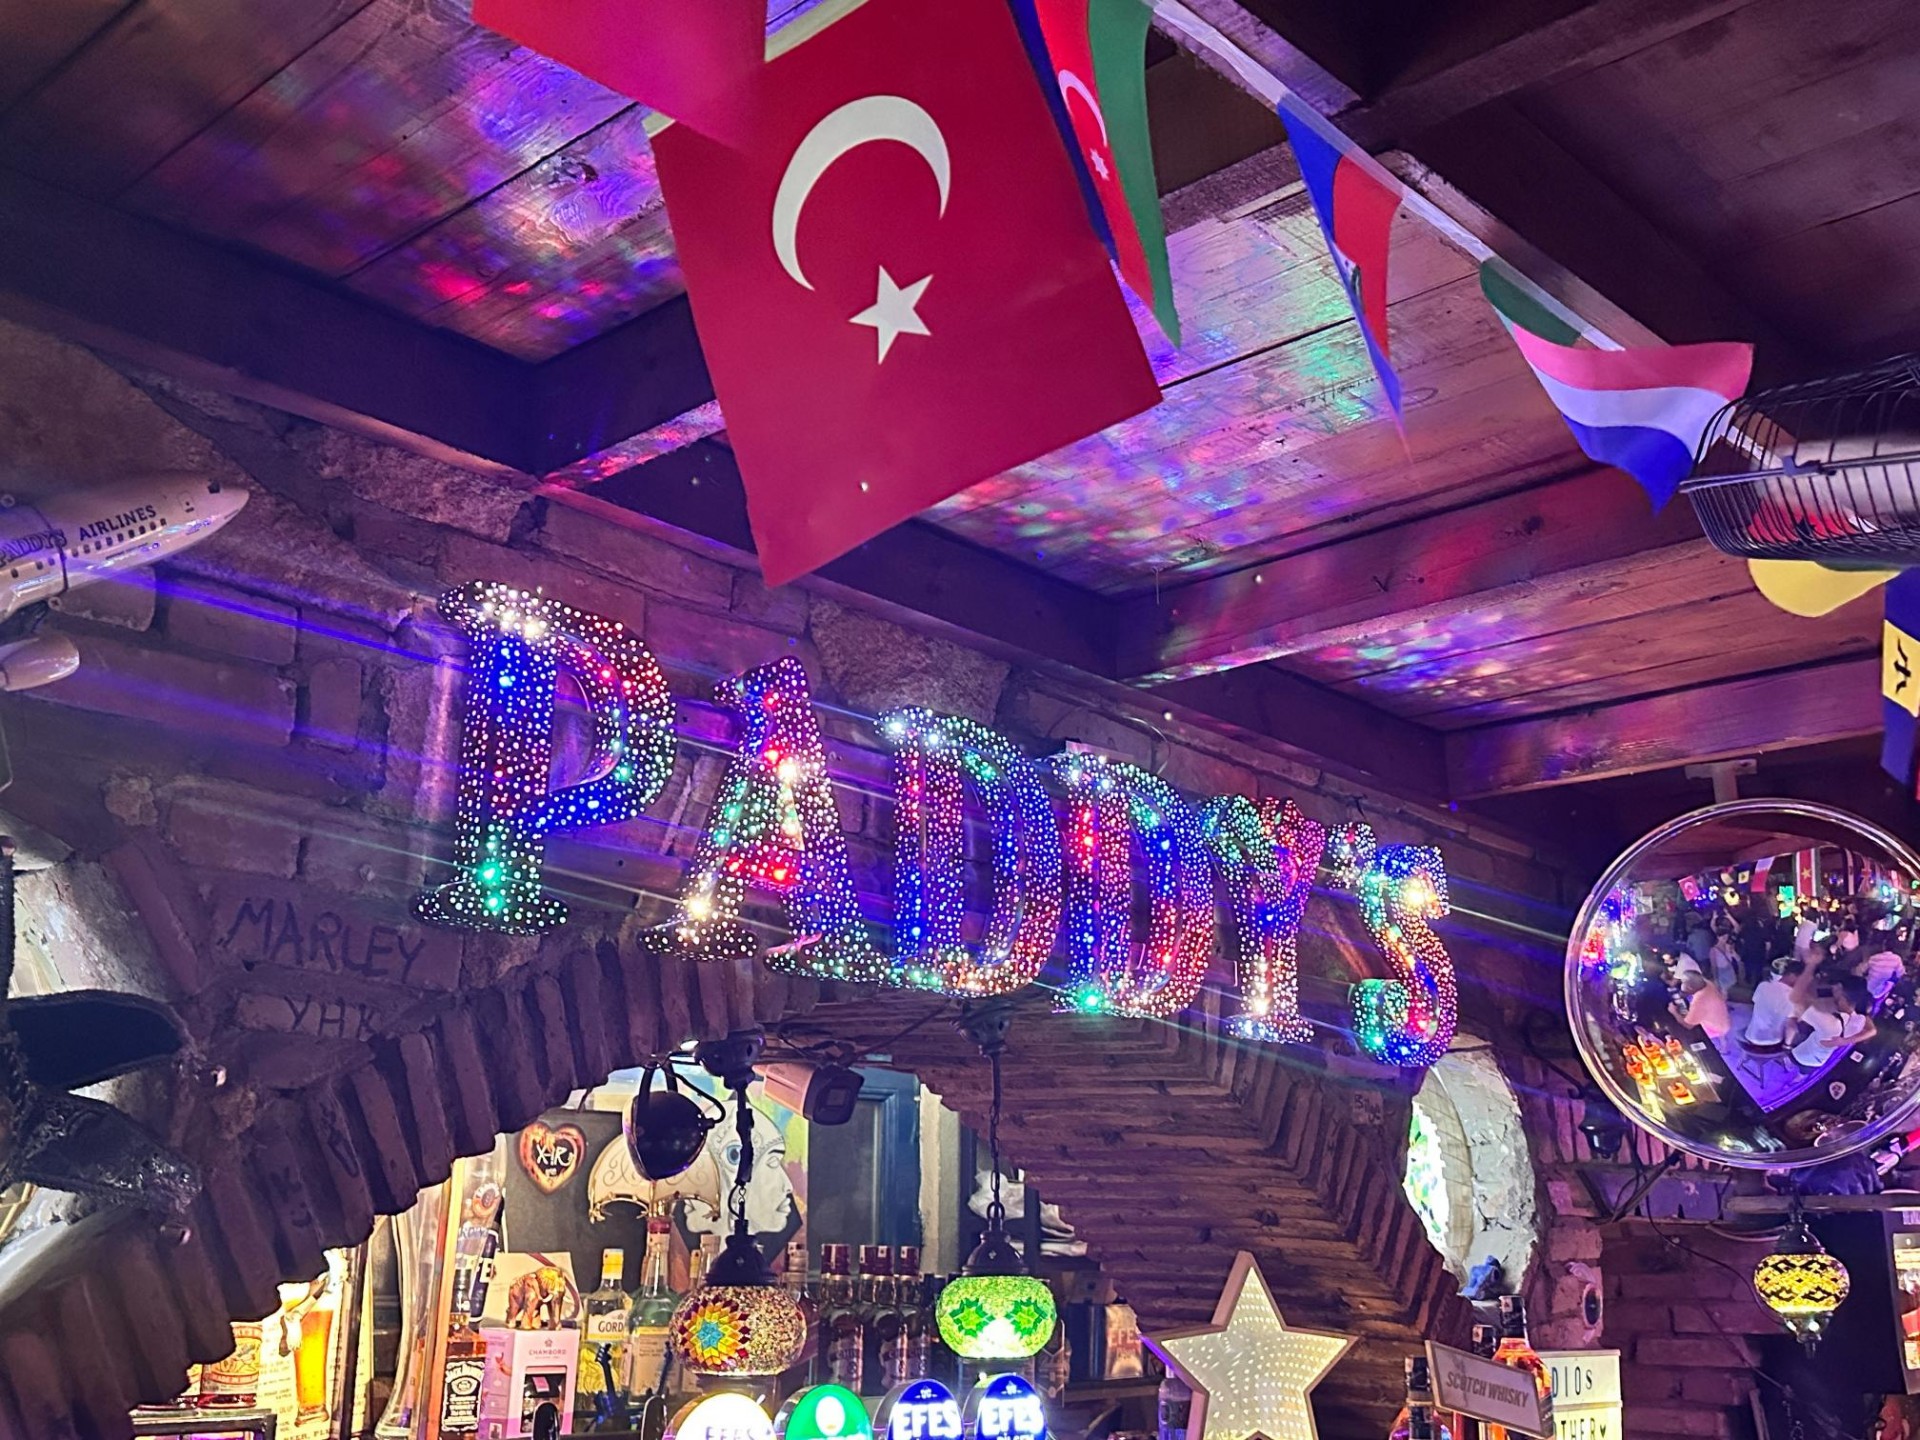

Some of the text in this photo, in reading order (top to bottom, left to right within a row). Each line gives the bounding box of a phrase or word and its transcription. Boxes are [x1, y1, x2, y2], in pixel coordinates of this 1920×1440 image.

[79, 505, 157, 541] AIRLINES
[216, 898, 425, 985] MARLEY
[1446, 1371, 1530, 1408] SCOTCH WHISKY
[893, 1400, 963, 1440] EFES
[981, 1395, 1044, 1437] EFES
